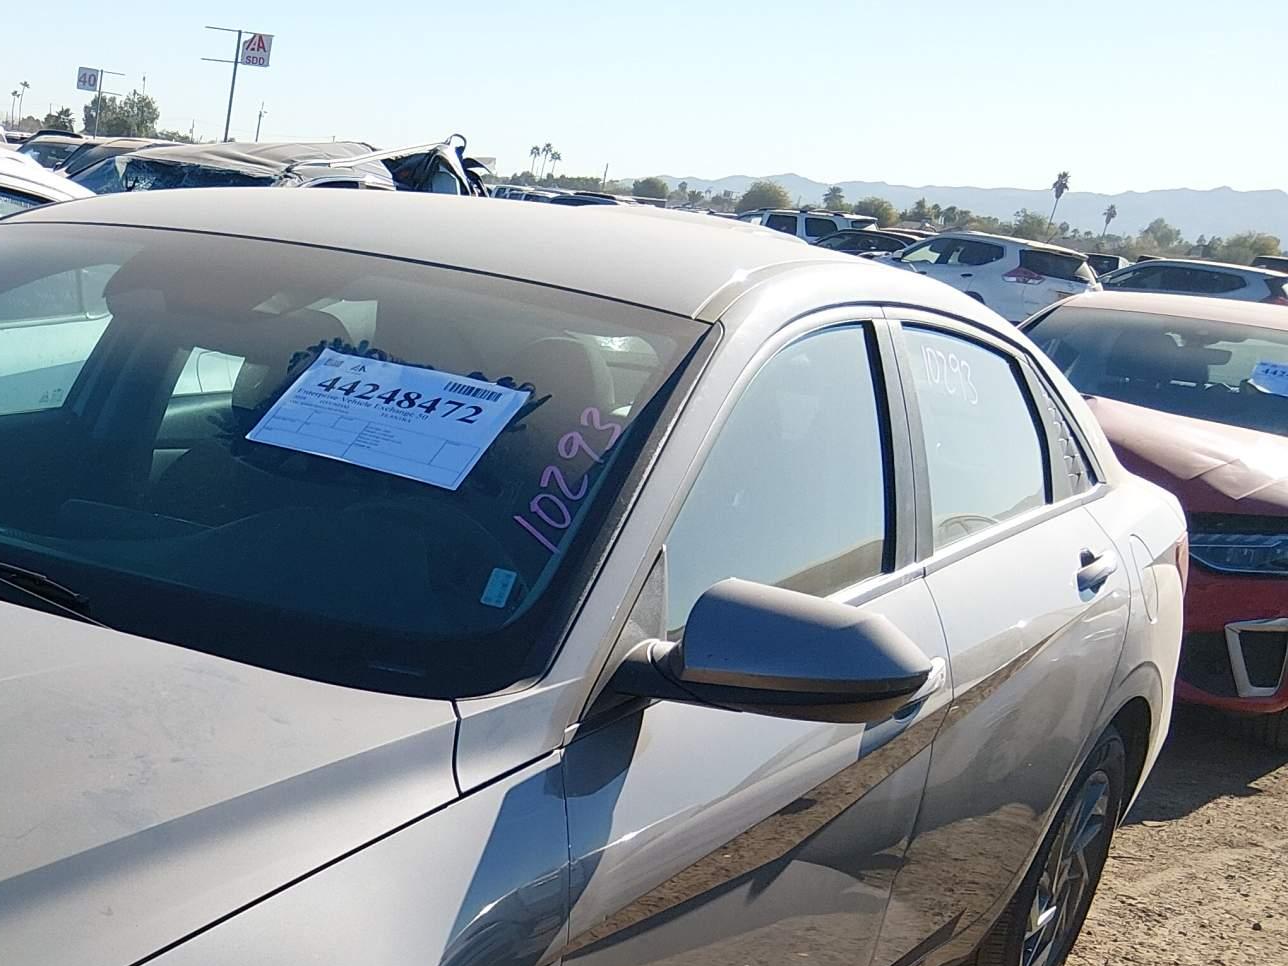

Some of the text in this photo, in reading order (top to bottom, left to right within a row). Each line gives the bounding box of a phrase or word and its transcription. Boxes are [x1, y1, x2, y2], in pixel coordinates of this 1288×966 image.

[78, 73, 98, 87] 40
[318, 376, 483, 424] 44248472
[921, 344, 978, 405] 10293
[513, 407, 622, 556] 10293
